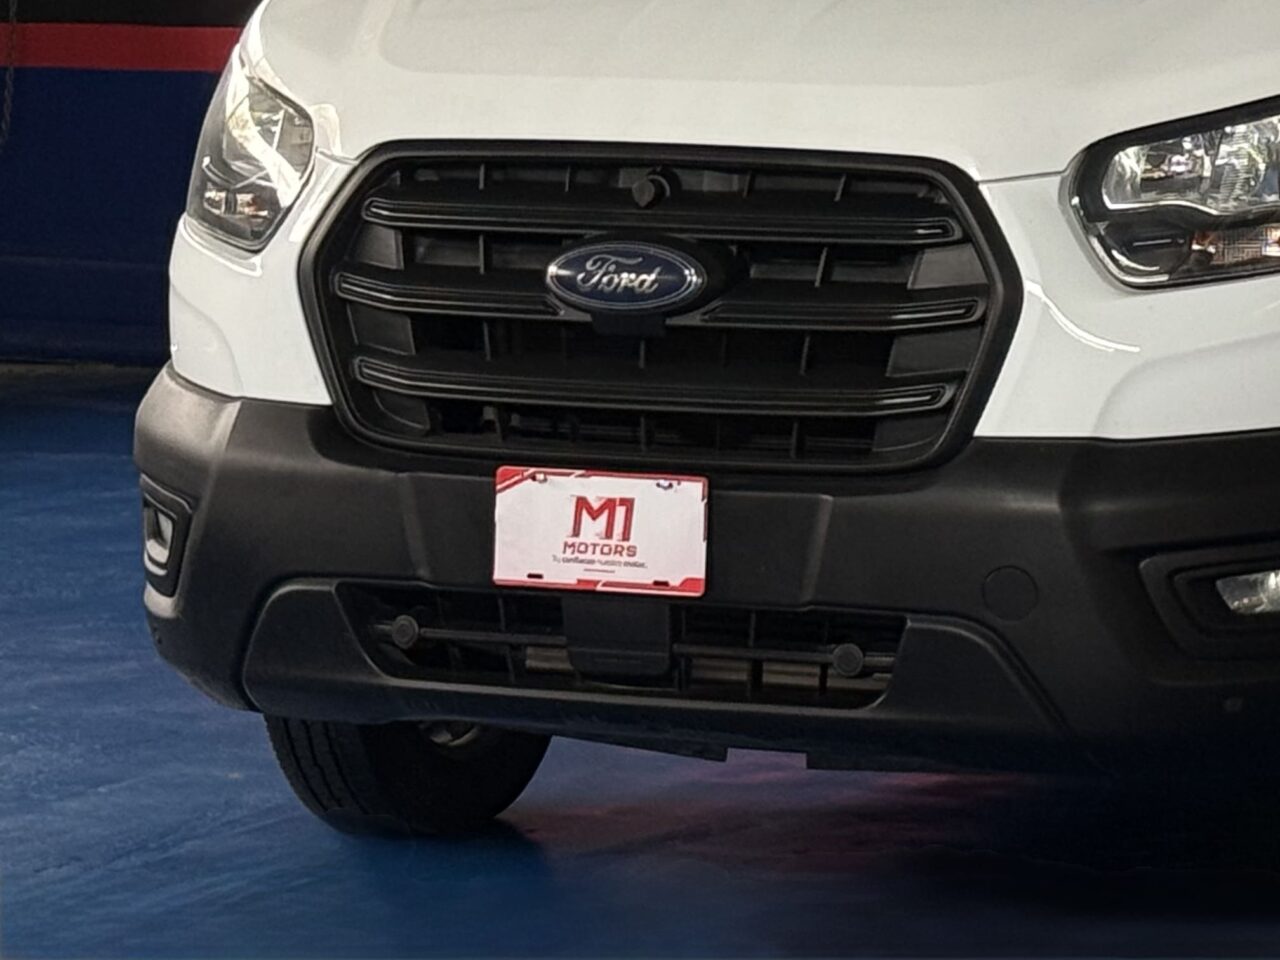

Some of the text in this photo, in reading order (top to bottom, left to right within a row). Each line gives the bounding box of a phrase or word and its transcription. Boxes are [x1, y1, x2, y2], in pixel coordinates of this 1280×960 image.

[577, 254, 662, 292] Ford
[570, 496, 635, 541] M1
[562, 542, 637, 557] MOTORS
